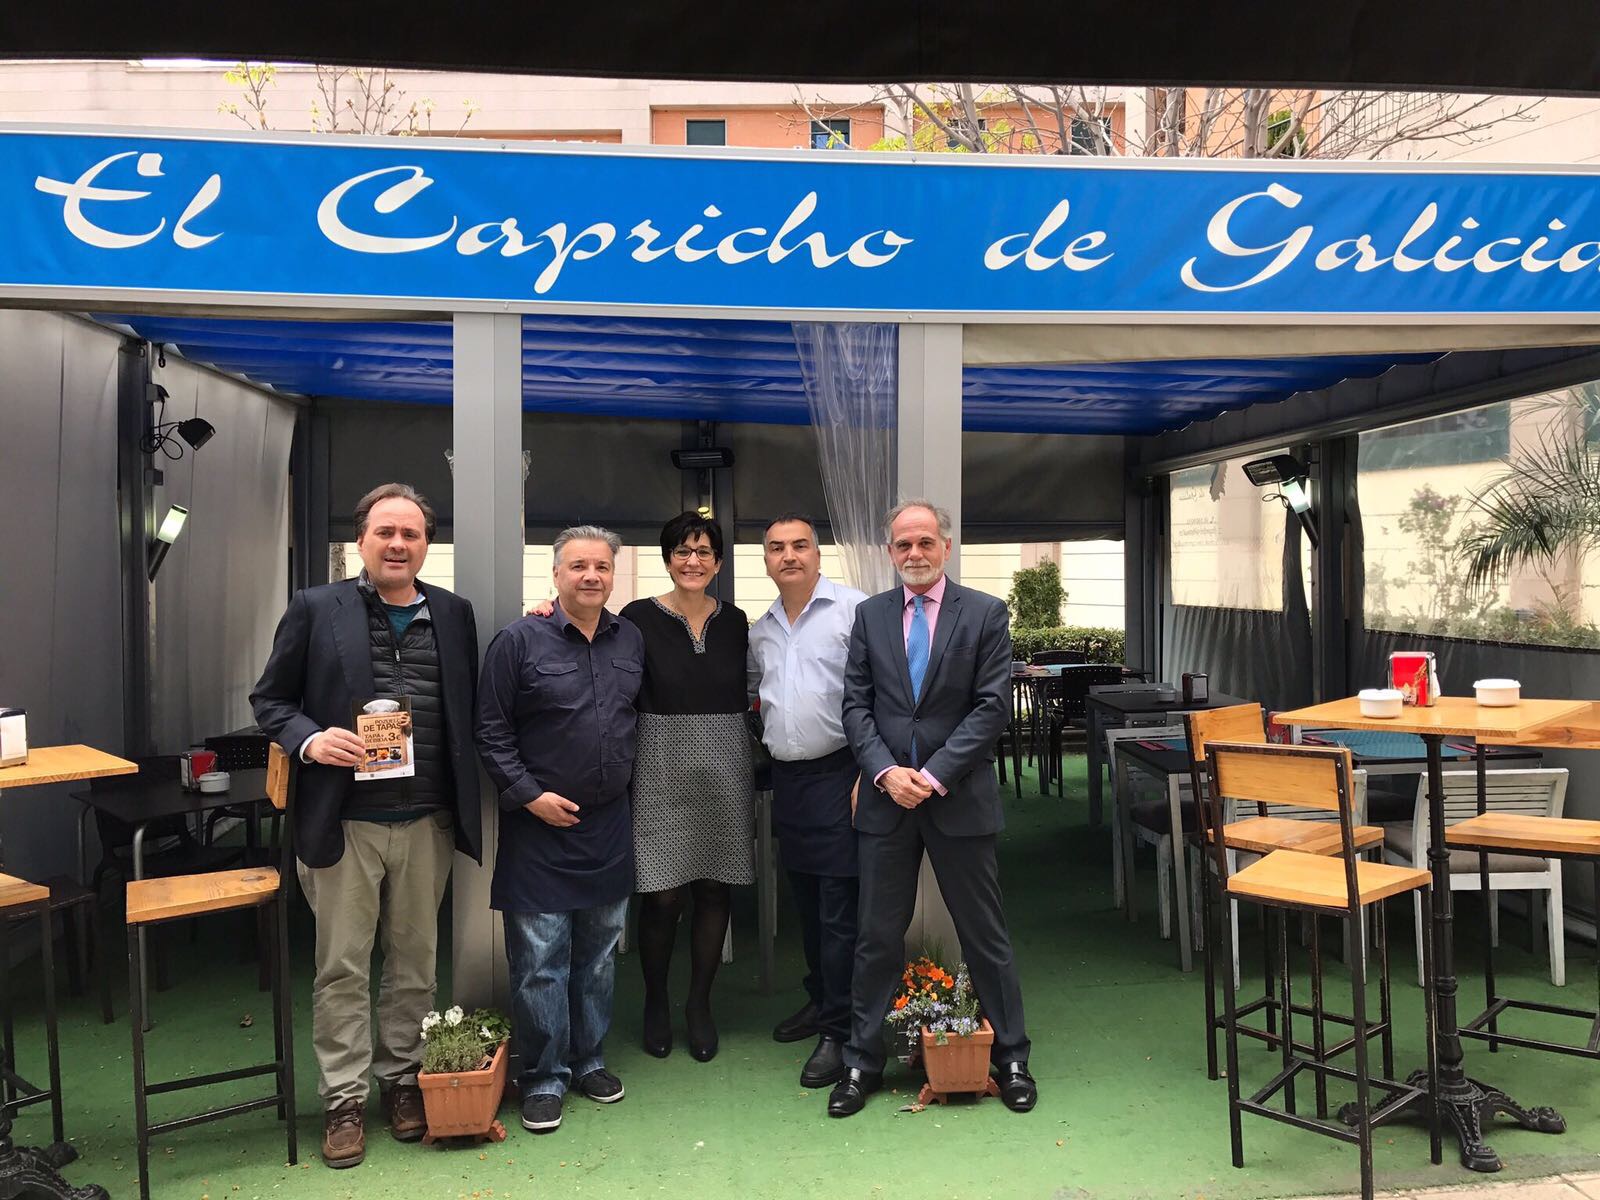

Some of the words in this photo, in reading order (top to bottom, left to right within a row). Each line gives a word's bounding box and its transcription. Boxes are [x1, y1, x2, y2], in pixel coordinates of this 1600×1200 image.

[35, 152, 222, 249] El
[317, 165, 913, 294] Capricho
[984, 199, 1114, 271] de
[376, 723, 401, 731] TAPAS
